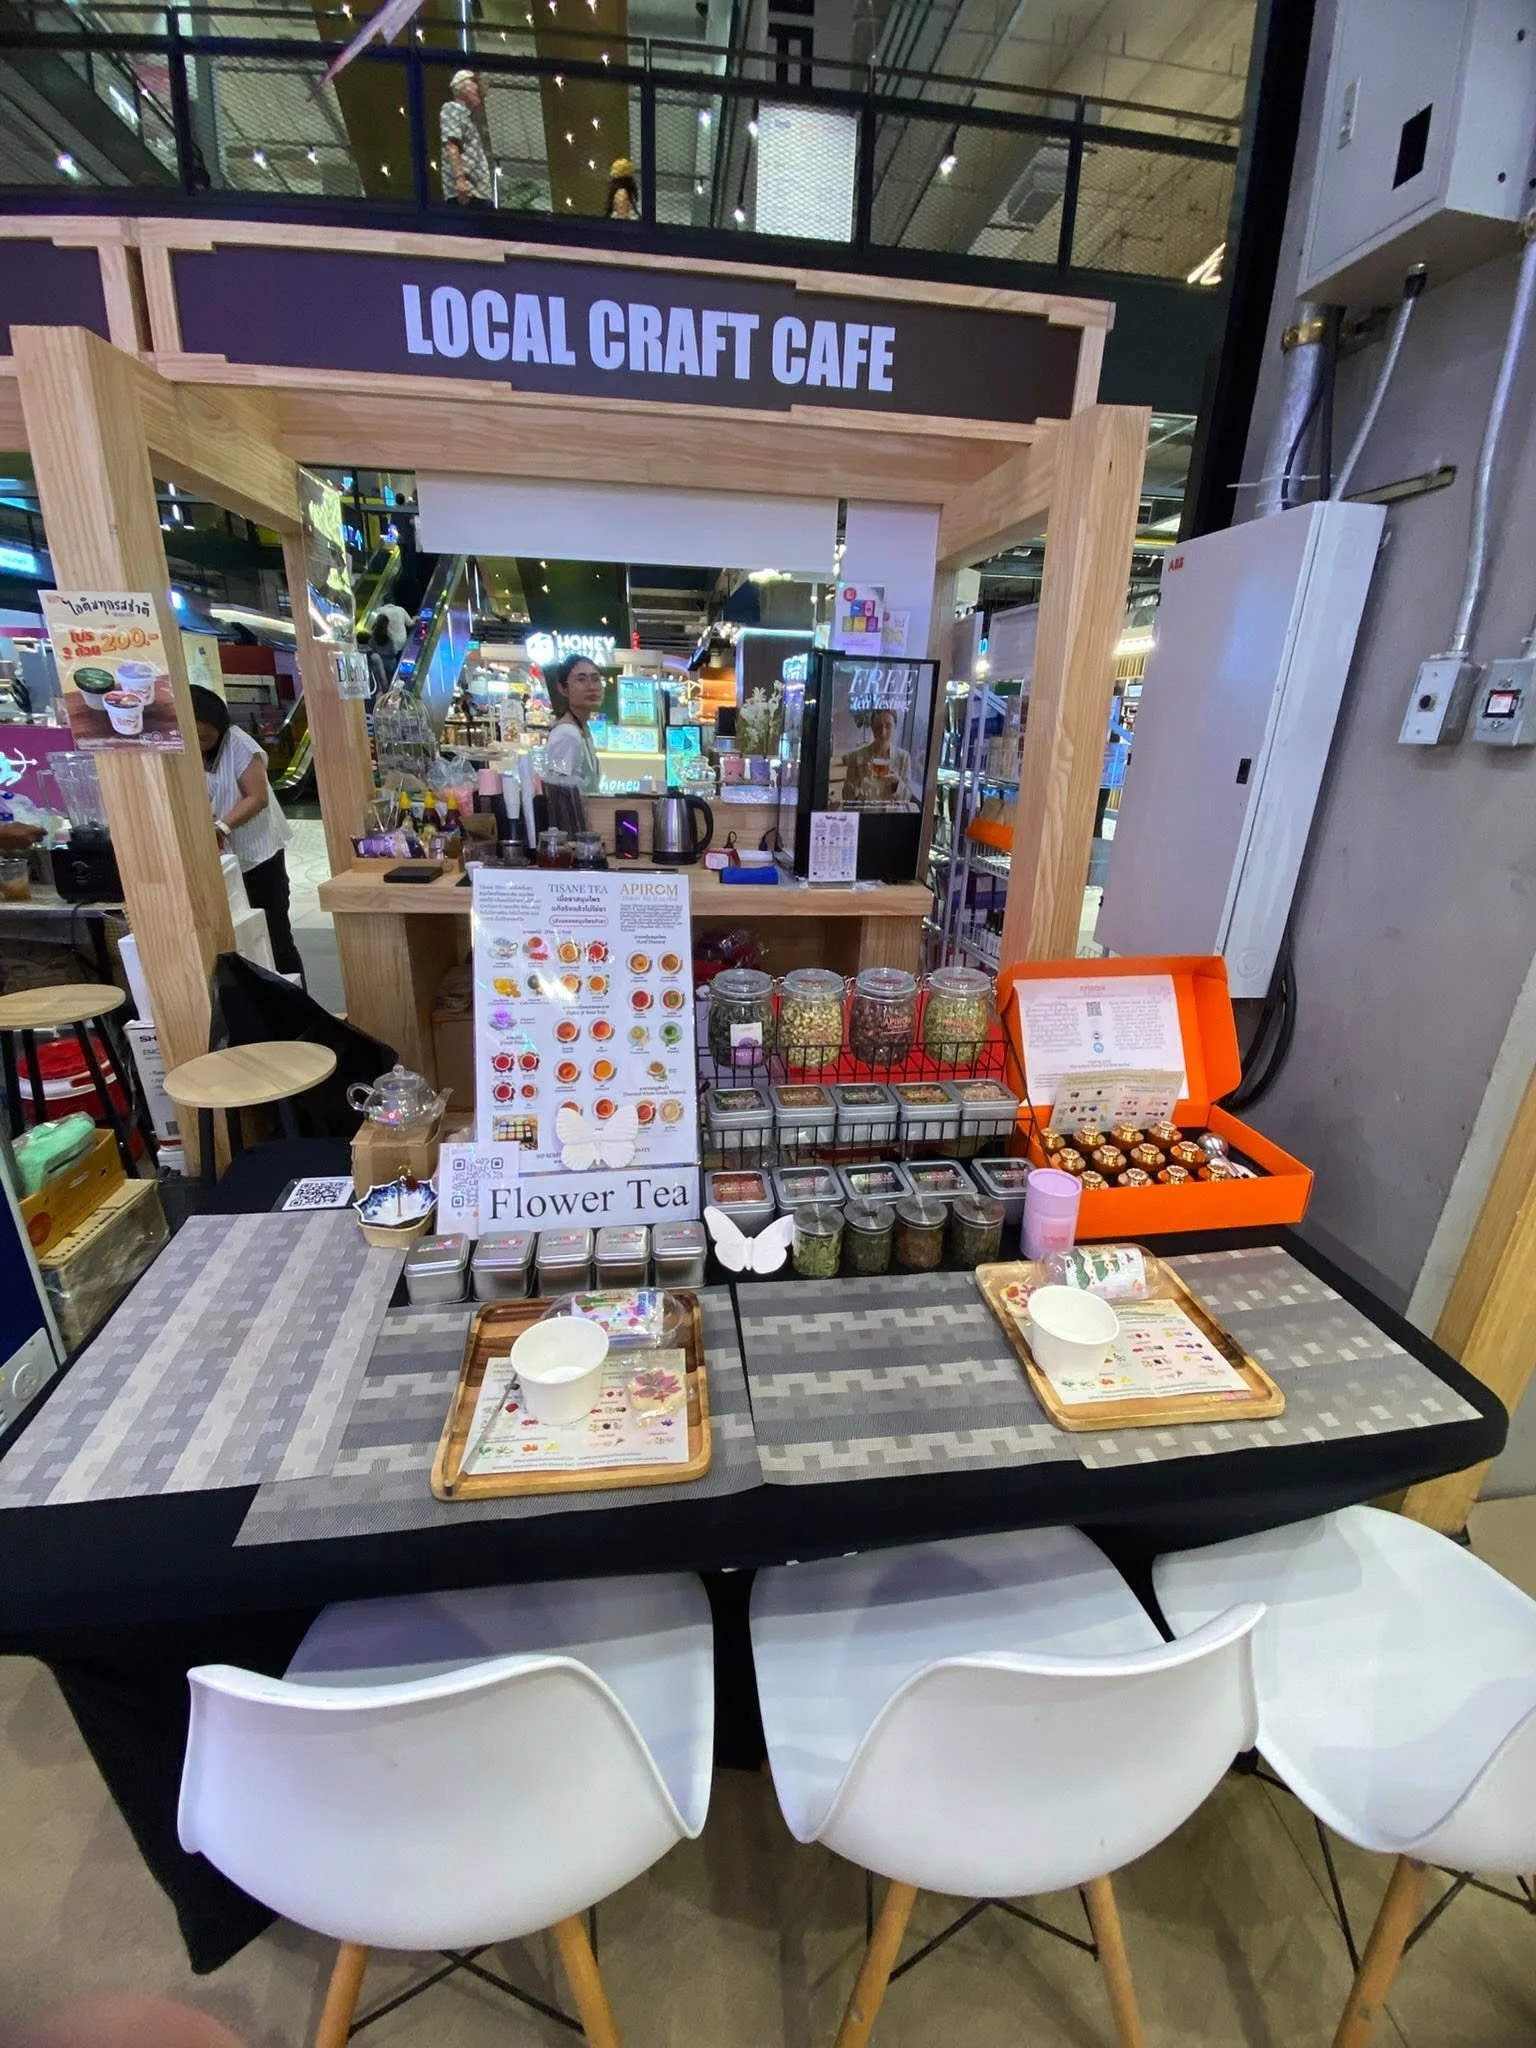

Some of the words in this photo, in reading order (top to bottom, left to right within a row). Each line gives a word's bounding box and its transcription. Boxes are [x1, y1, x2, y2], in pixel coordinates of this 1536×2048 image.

[402, 284, 576, 366] LOCAL
[588, 299, 759, 380] CRAFT
[771, 315, 896, 392] CAFE
[556, 633, 615, 650] HONEY
[847, 669, 919, 694] FREE
[548, 883, 586, 894] TISANE
[587, 884, 608, 895] TEA
[620, 883, 678, 895] APIROM
[488, 1186, 616, 1219] Flower
[627, 1179, 690, 1210] Tea
